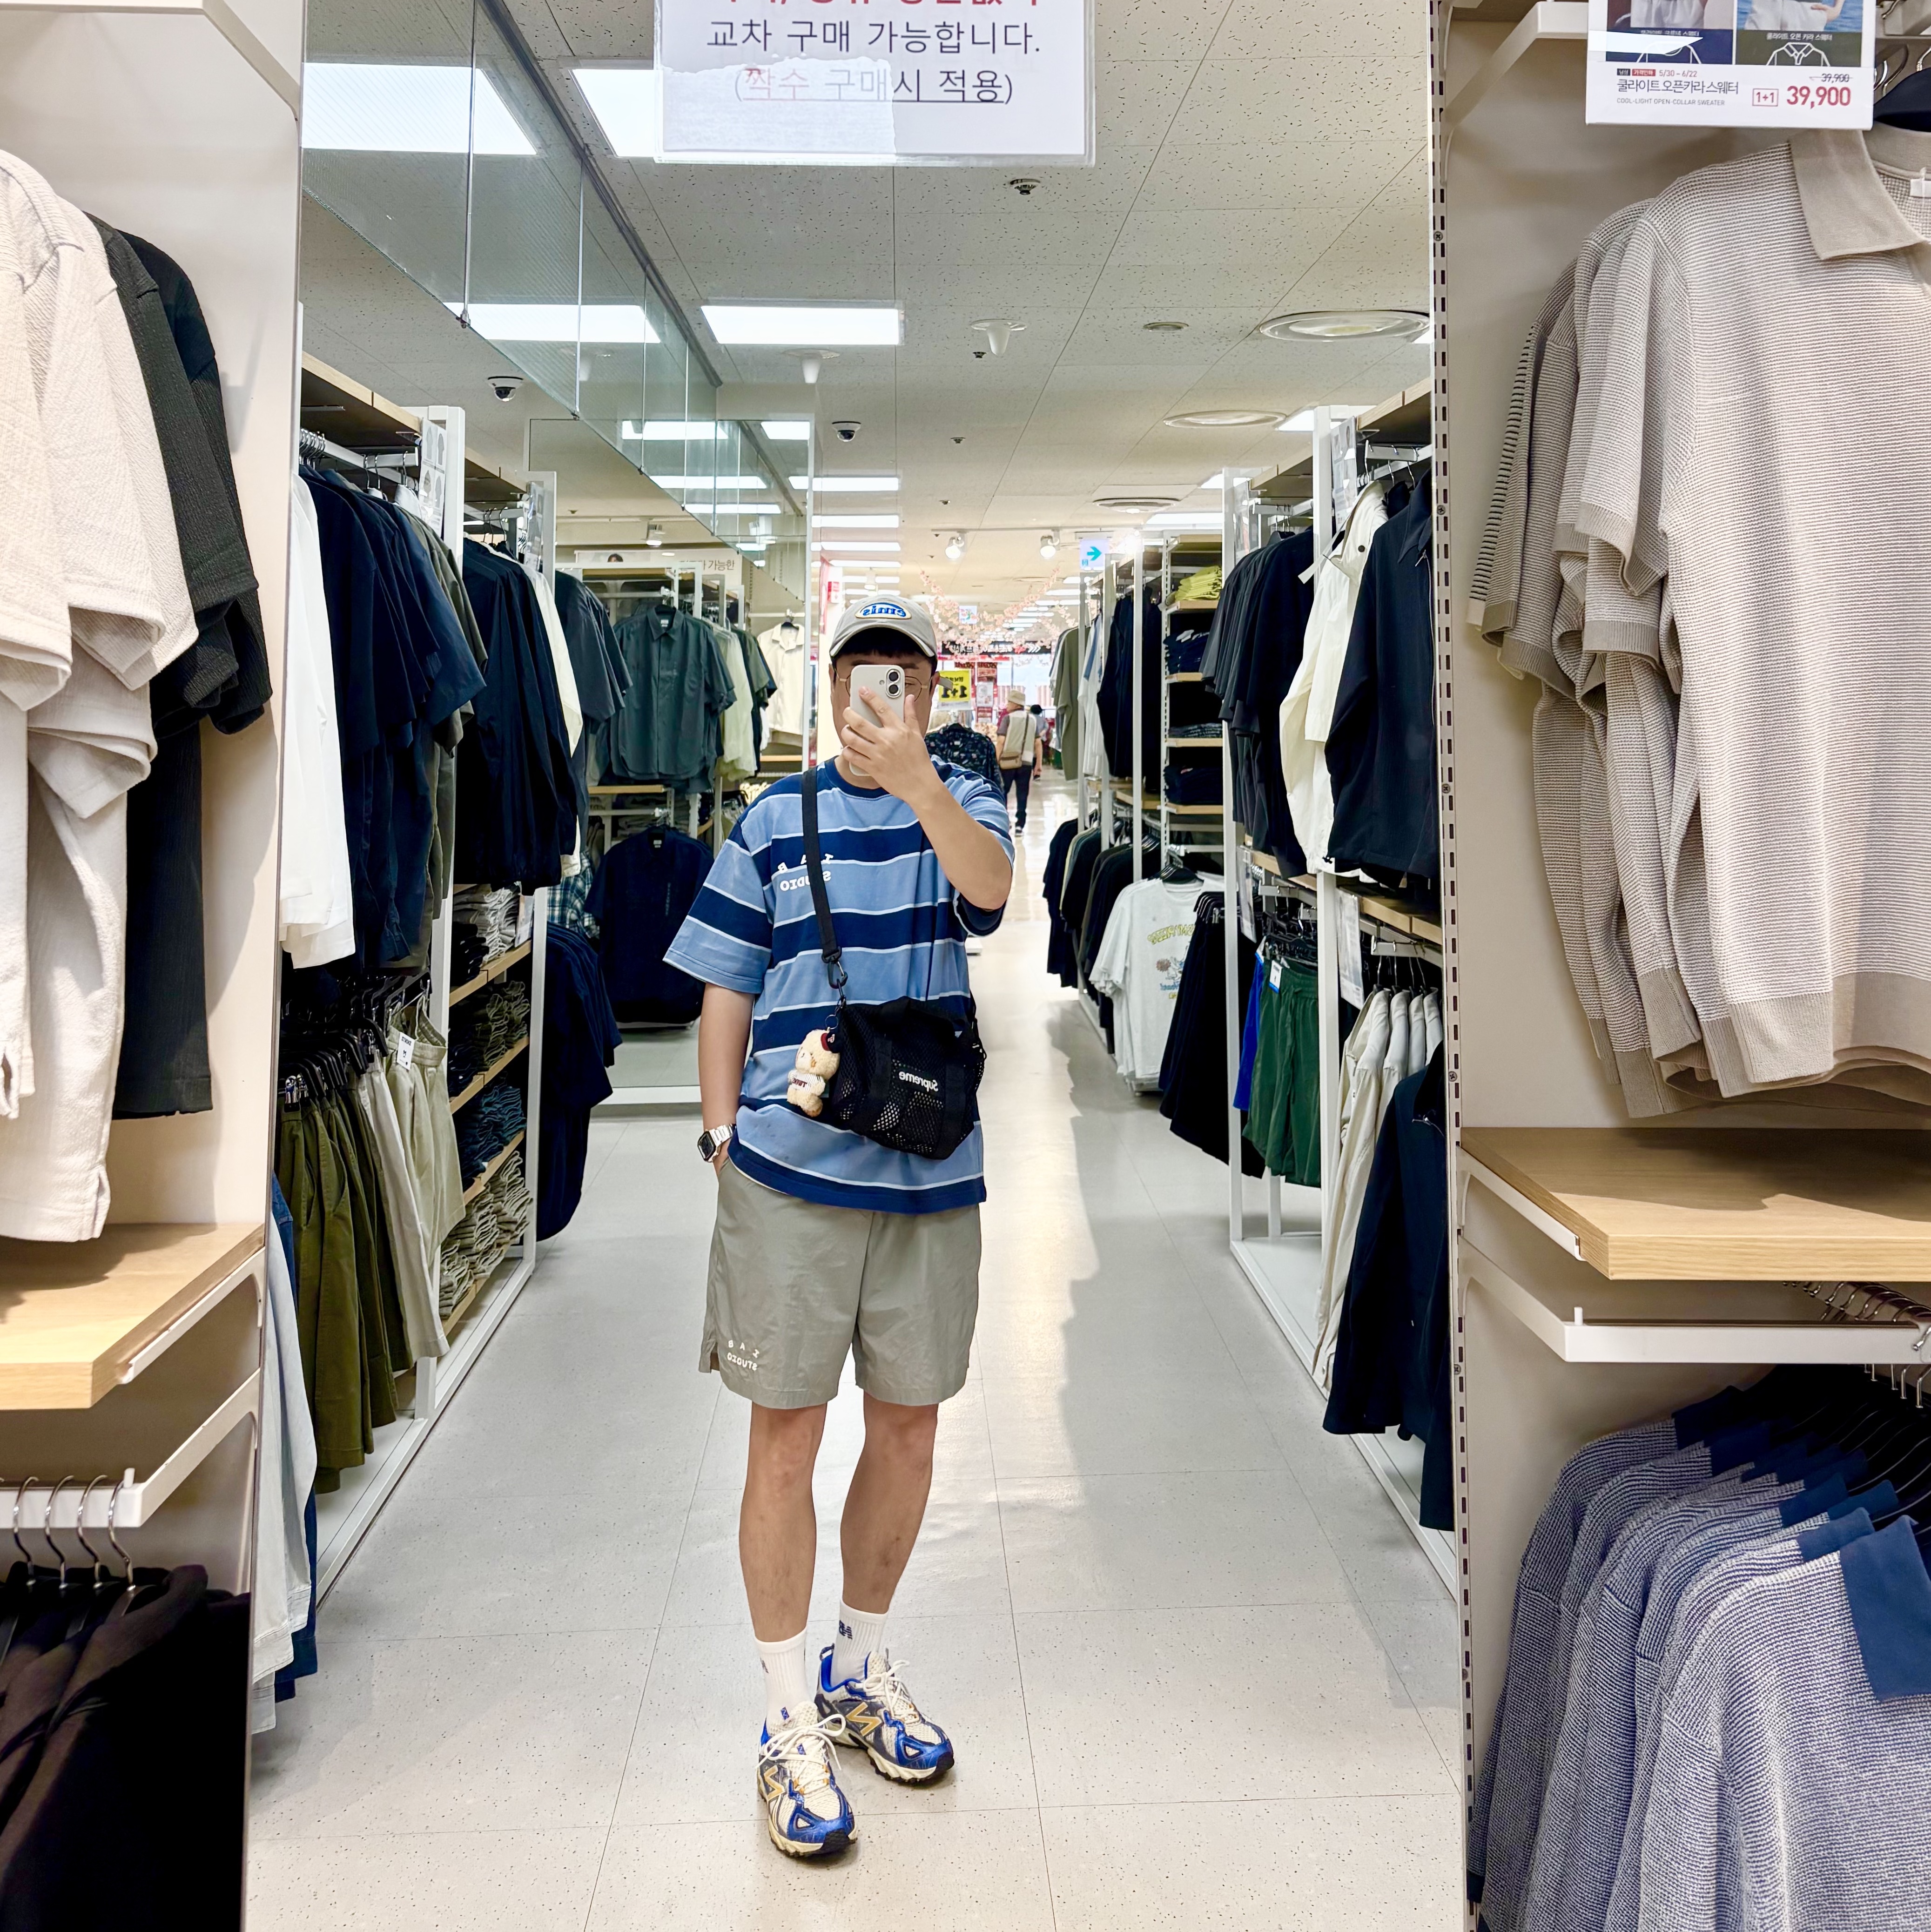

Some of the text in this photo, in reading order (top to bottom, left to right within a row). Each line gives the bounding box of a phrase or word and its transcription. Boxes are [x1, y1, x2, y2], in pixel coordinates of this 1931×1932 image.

[706, 19, 1040, 54] 교차 구매 가능합니다.
[939, 69, 1013, 105] 적용)
[1617, 79, 1739, 95] 쿨라이트 오픈카라 스웨터
[1756, 85, 1851, 109] 1+1 39,900
[708, 559, 735, 571] 가능한
